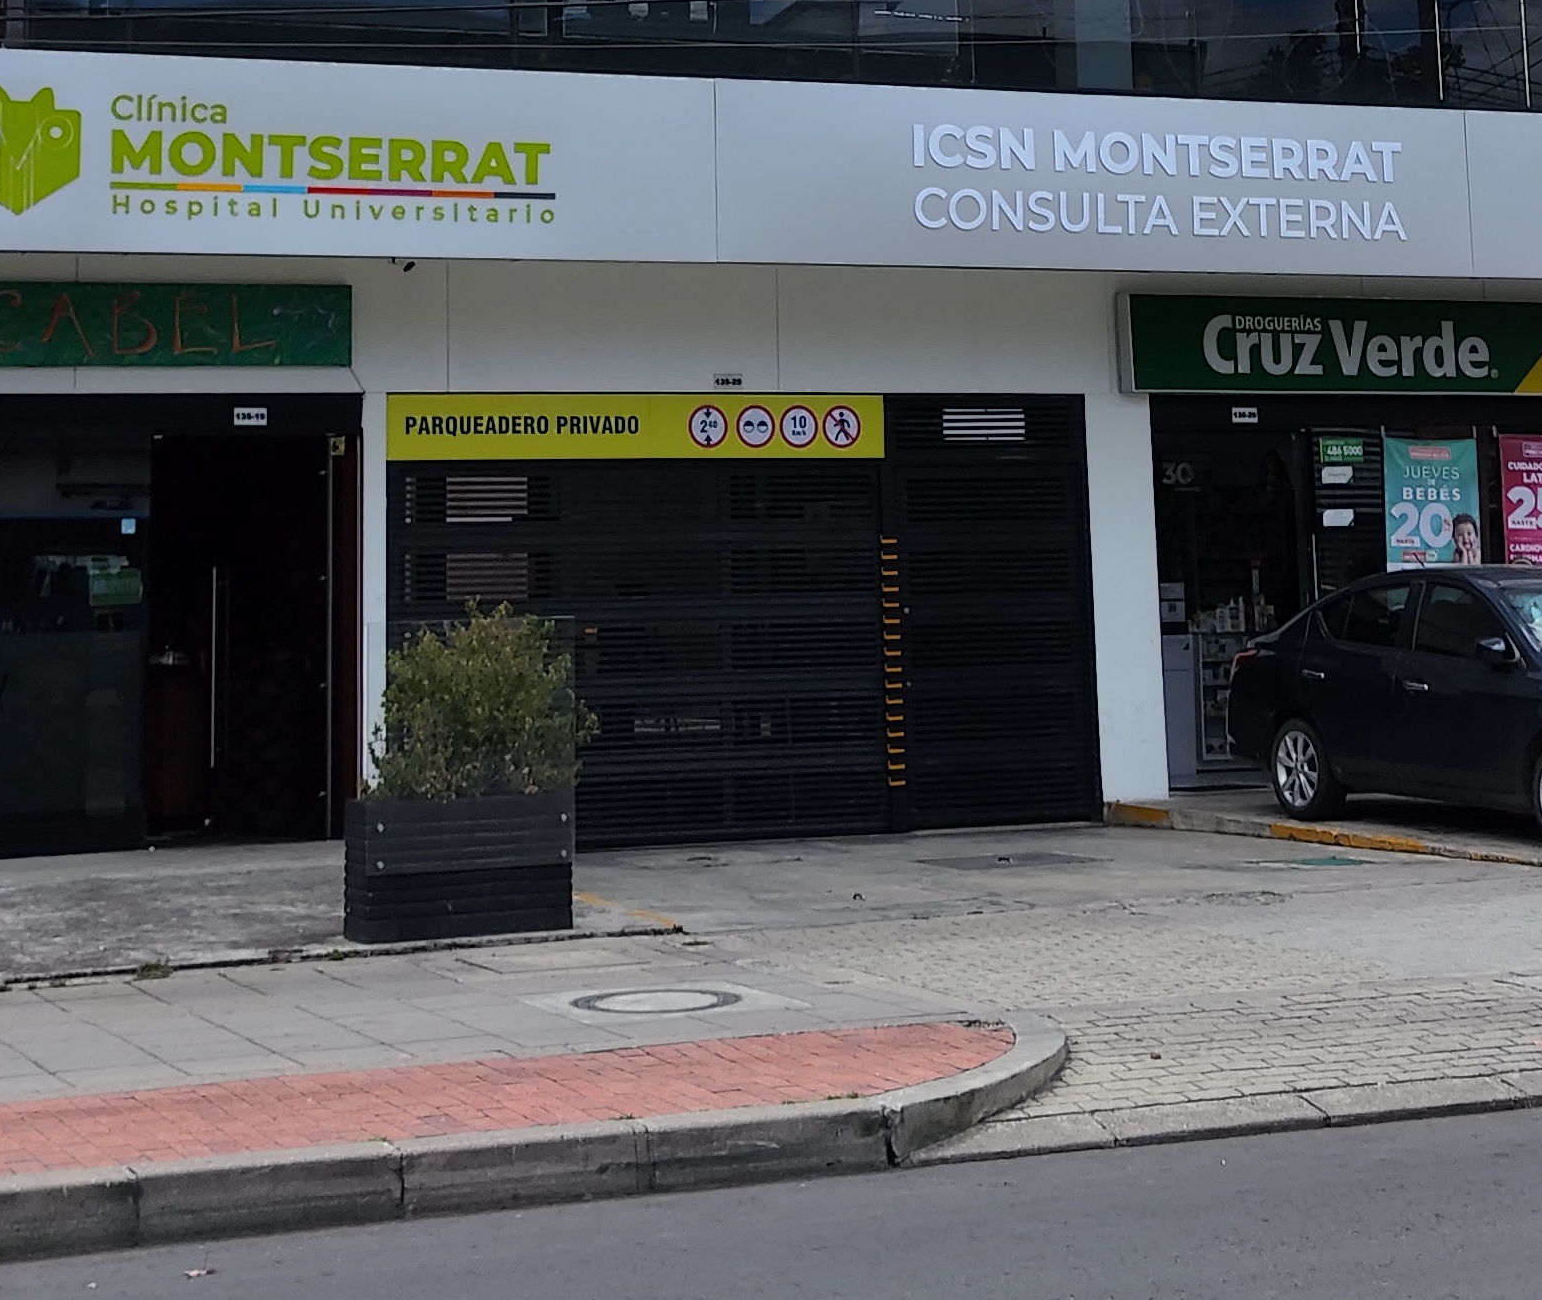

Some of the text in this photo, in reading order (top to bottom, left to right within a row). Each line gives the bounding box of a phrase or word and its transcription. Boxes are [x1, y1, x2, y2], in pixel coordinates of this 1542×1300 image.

[110, 94, 228, 125] Clínica
[110, 128, 551, 186] MONTSERRAT
[912, 123, 1403, 183] ICSN MONTSERRAT
[111, 194, 556, 225] Hospital Universitario
[913, 186, 1408, 241] CONSULTA EXTERNA
[1234, 313, 1323, 333] DROGUERÍAS
[1202, 313, 1491, 379] Cruz Verde
[404, 413, 641, 438] PARQUEADERO PRIVADO
[790, 415, 808, 429] 10
[1402, 465, 1461, 480] JUEVES
[1402, 485, 1462, 501] BEBÉS
